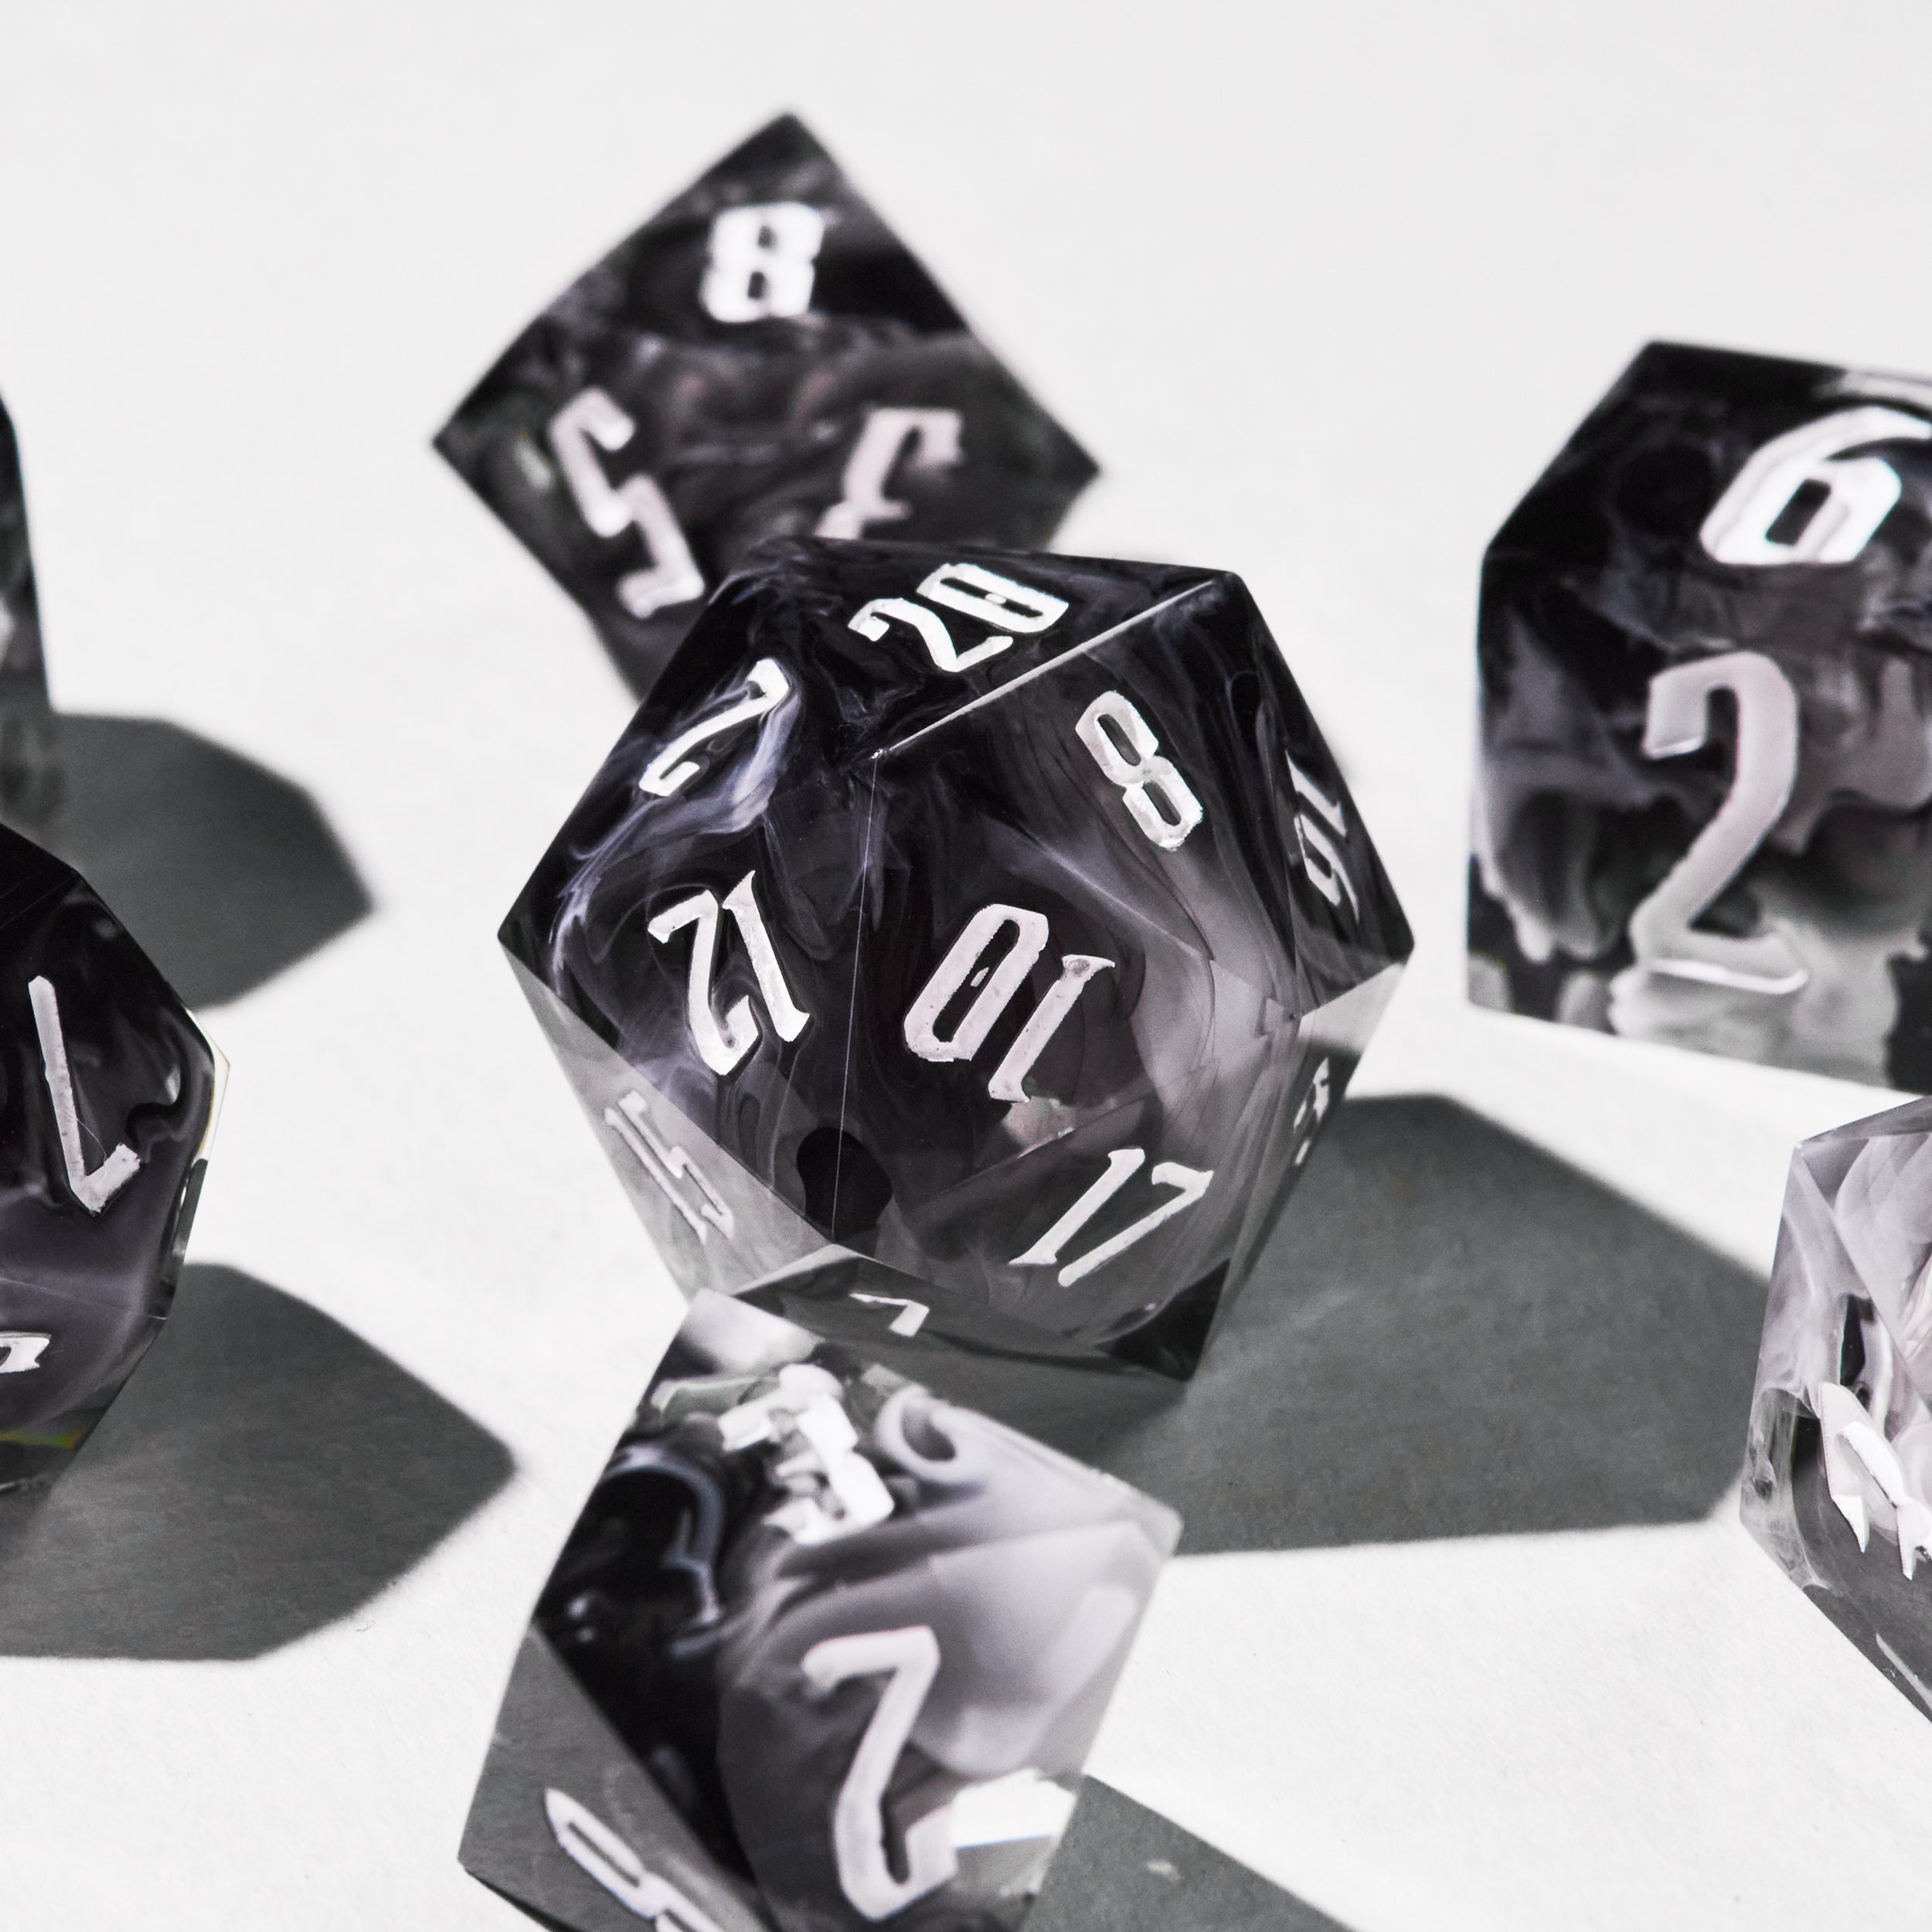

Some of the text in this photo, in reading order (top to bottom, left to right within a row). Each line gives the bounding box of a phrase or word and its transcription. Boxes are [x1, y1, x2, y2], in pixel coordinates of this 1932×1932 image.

[699, 199, 827, 323] 8
[1700, 405, 1932, 566] 6
[848, 563, 1069, 672] 20
[1075, 690, 1203, 852] 8
[1628, 651, 1808, 994] 2
[1008, 1145, 1214, 1287] 17
[802, 1624, 957, 1921] 2
